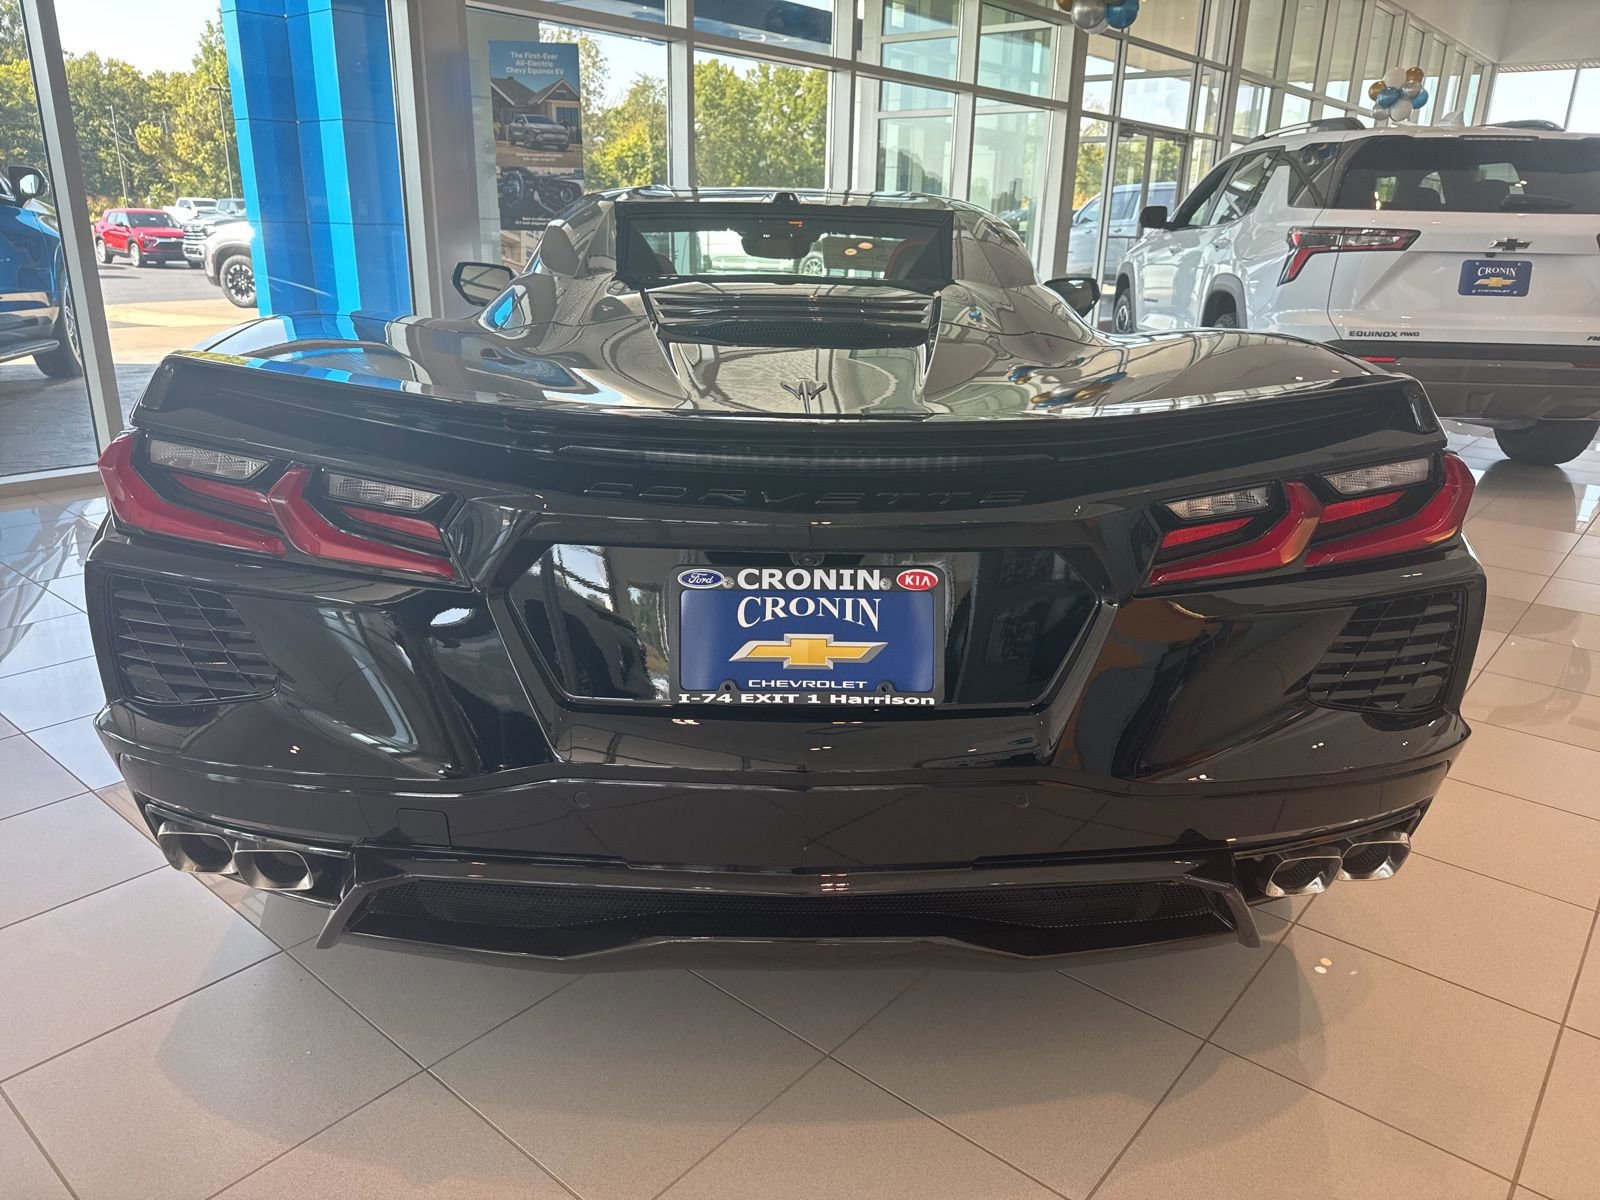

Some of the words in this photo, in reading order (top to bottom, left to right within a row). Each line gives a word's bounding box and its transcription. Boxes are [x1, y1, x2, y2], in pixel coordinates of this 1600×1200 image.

[511, 51, 523, 59] The
[524, 52, 558, 60] First-Ever
[515, 59, 554, 67] All-Electric
[505, 66, 527, 75] Chevy
[527, 67, 554, 75] Equinox
[1477, 266, 1517, 278] CRONIN
[583, 481, 1028, 505] CORVETTE
[687, 573, 714, 585] Ford
[737, 568, 881, 590] CRONIN
[904, 574, 931, 586] KIA
[737, 596, 882, 632] CRONIN
[748, 679, 868, 689] CHEVROLET
[678, 693, 732, 704] I-74
[741, 693, 800, 704] EXIT
[808, 694, 821, 704] 1
[830, 694, 935, 705] Harrison
